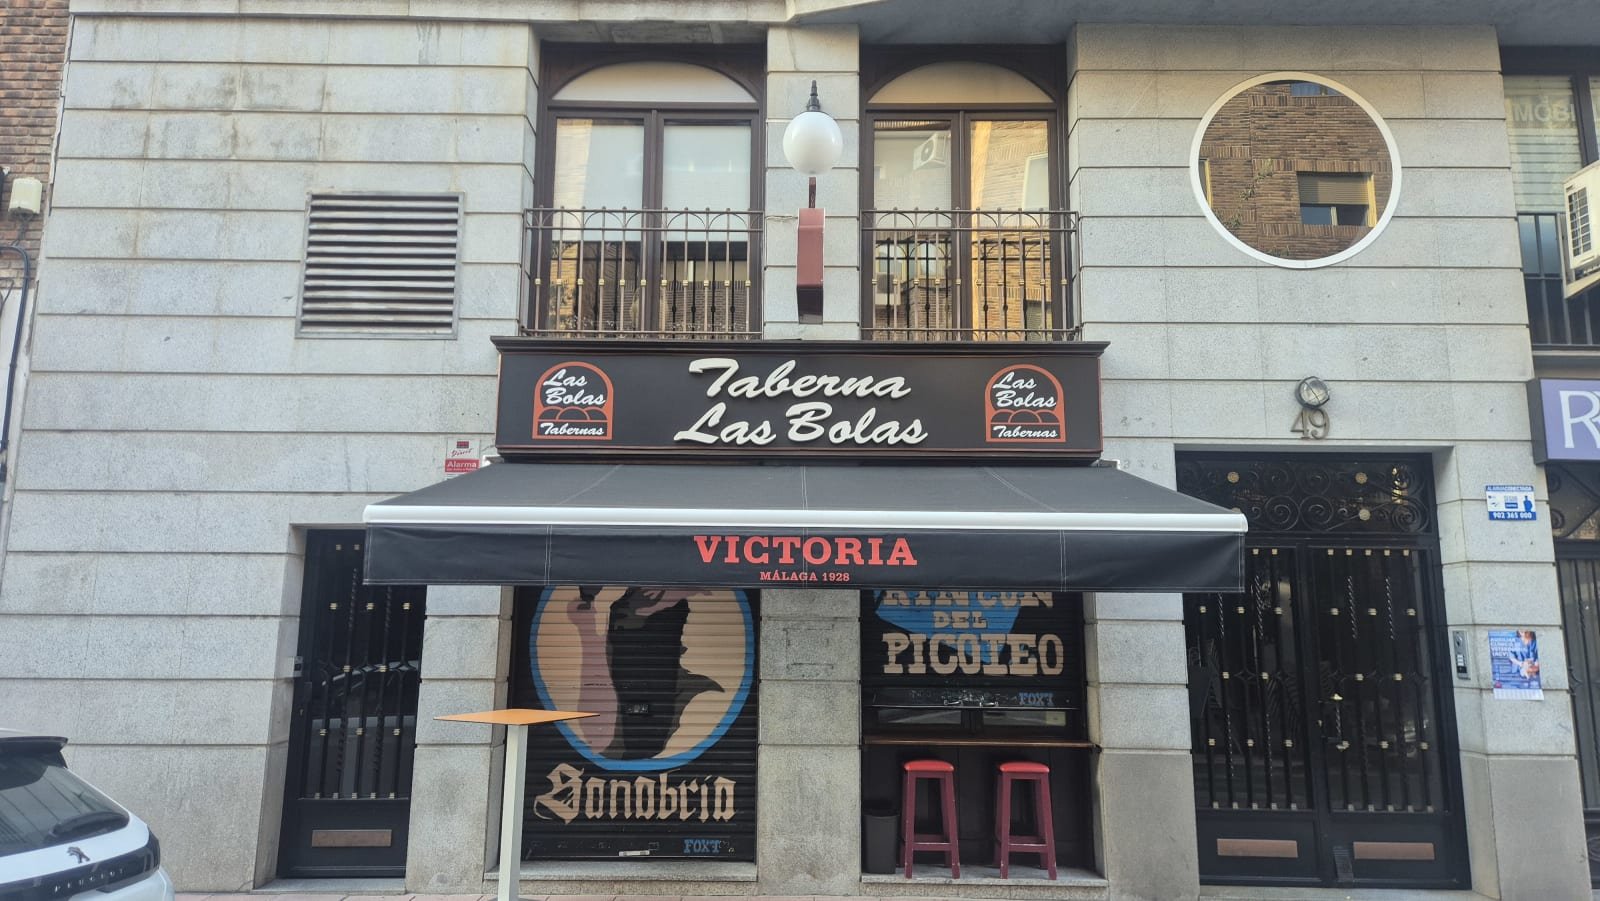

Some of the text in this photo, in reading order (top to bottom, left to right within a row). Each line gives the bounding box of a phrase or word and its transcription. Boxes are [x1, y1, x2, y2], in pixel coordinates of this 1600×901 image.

[543, 368, 588, 387] Las
[688, 357, 912, 399] Taberna
[992, 371, 1037, 389] Las
[545, 386, 606, 406] Bolas
[995, 389, 1057, 408] Bolas
[540, 422, 605, 436] Tabernas
[673, 401, 929, 445] Las Bolas
[992, 425, 1058, 438] Tabernas
[1290, 407, 1330, 440] 49
[1492, 511, 1506, 519] 902
[693, 535, 918, 565] VICTORIA
[759, 569, 850, 582] MÁLAGA 1928
[933, 611, 988, 628] DEL
[882, 633, 1065, 675] PICOTEO
